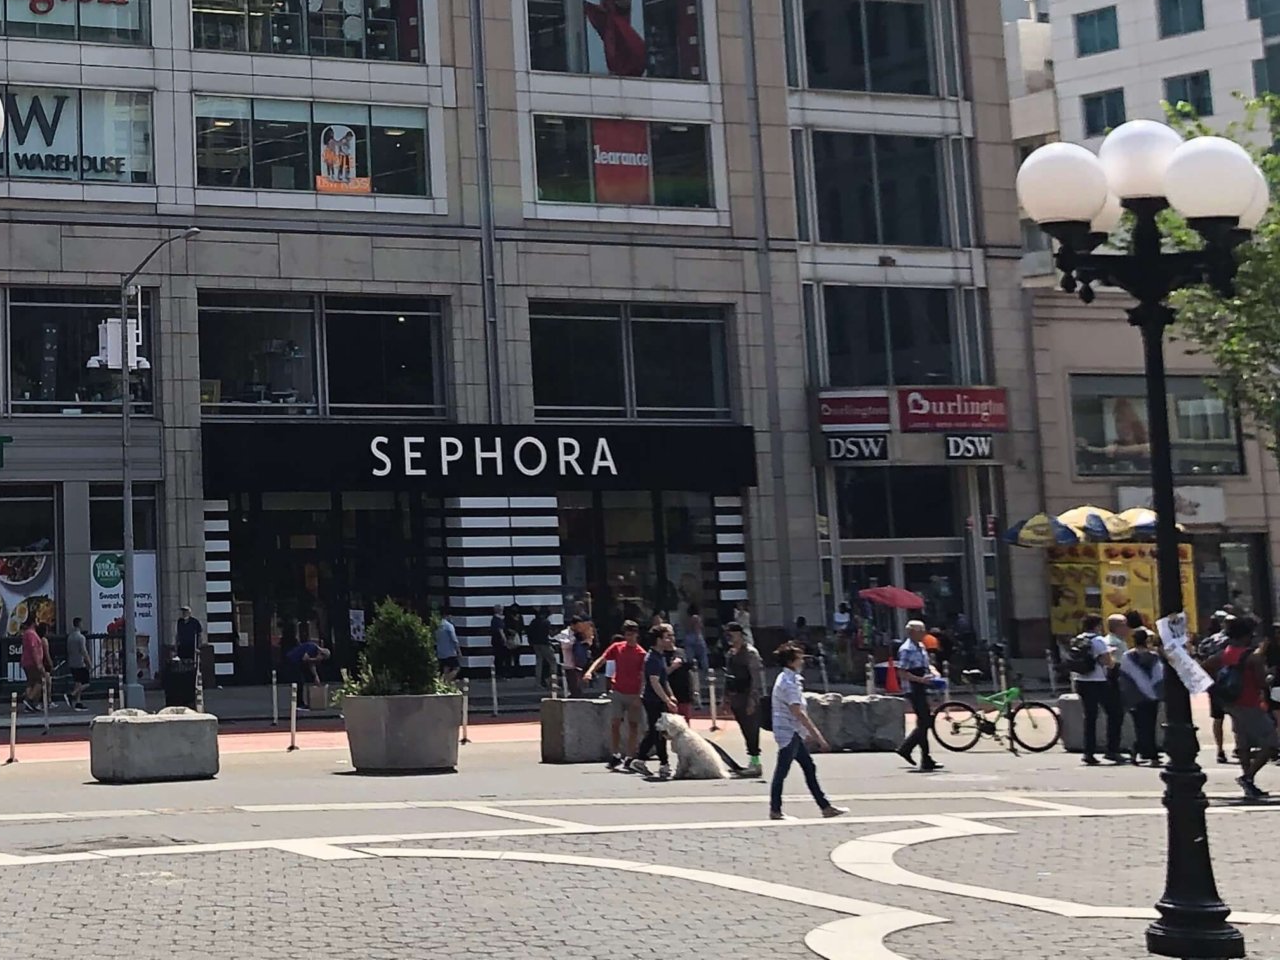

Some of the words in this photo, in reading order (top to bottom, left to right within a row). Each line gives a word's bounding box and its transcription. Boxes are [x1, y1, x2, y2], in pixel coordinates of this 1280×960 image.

[14, 151, 126, 175] WAREHOUSE
[593, 144, 649, 167] learance
[370, 436, 618, 476] SEPHORA
[828, 437, 885, 459] DSW
[947, 436, 992, 457] DSW
